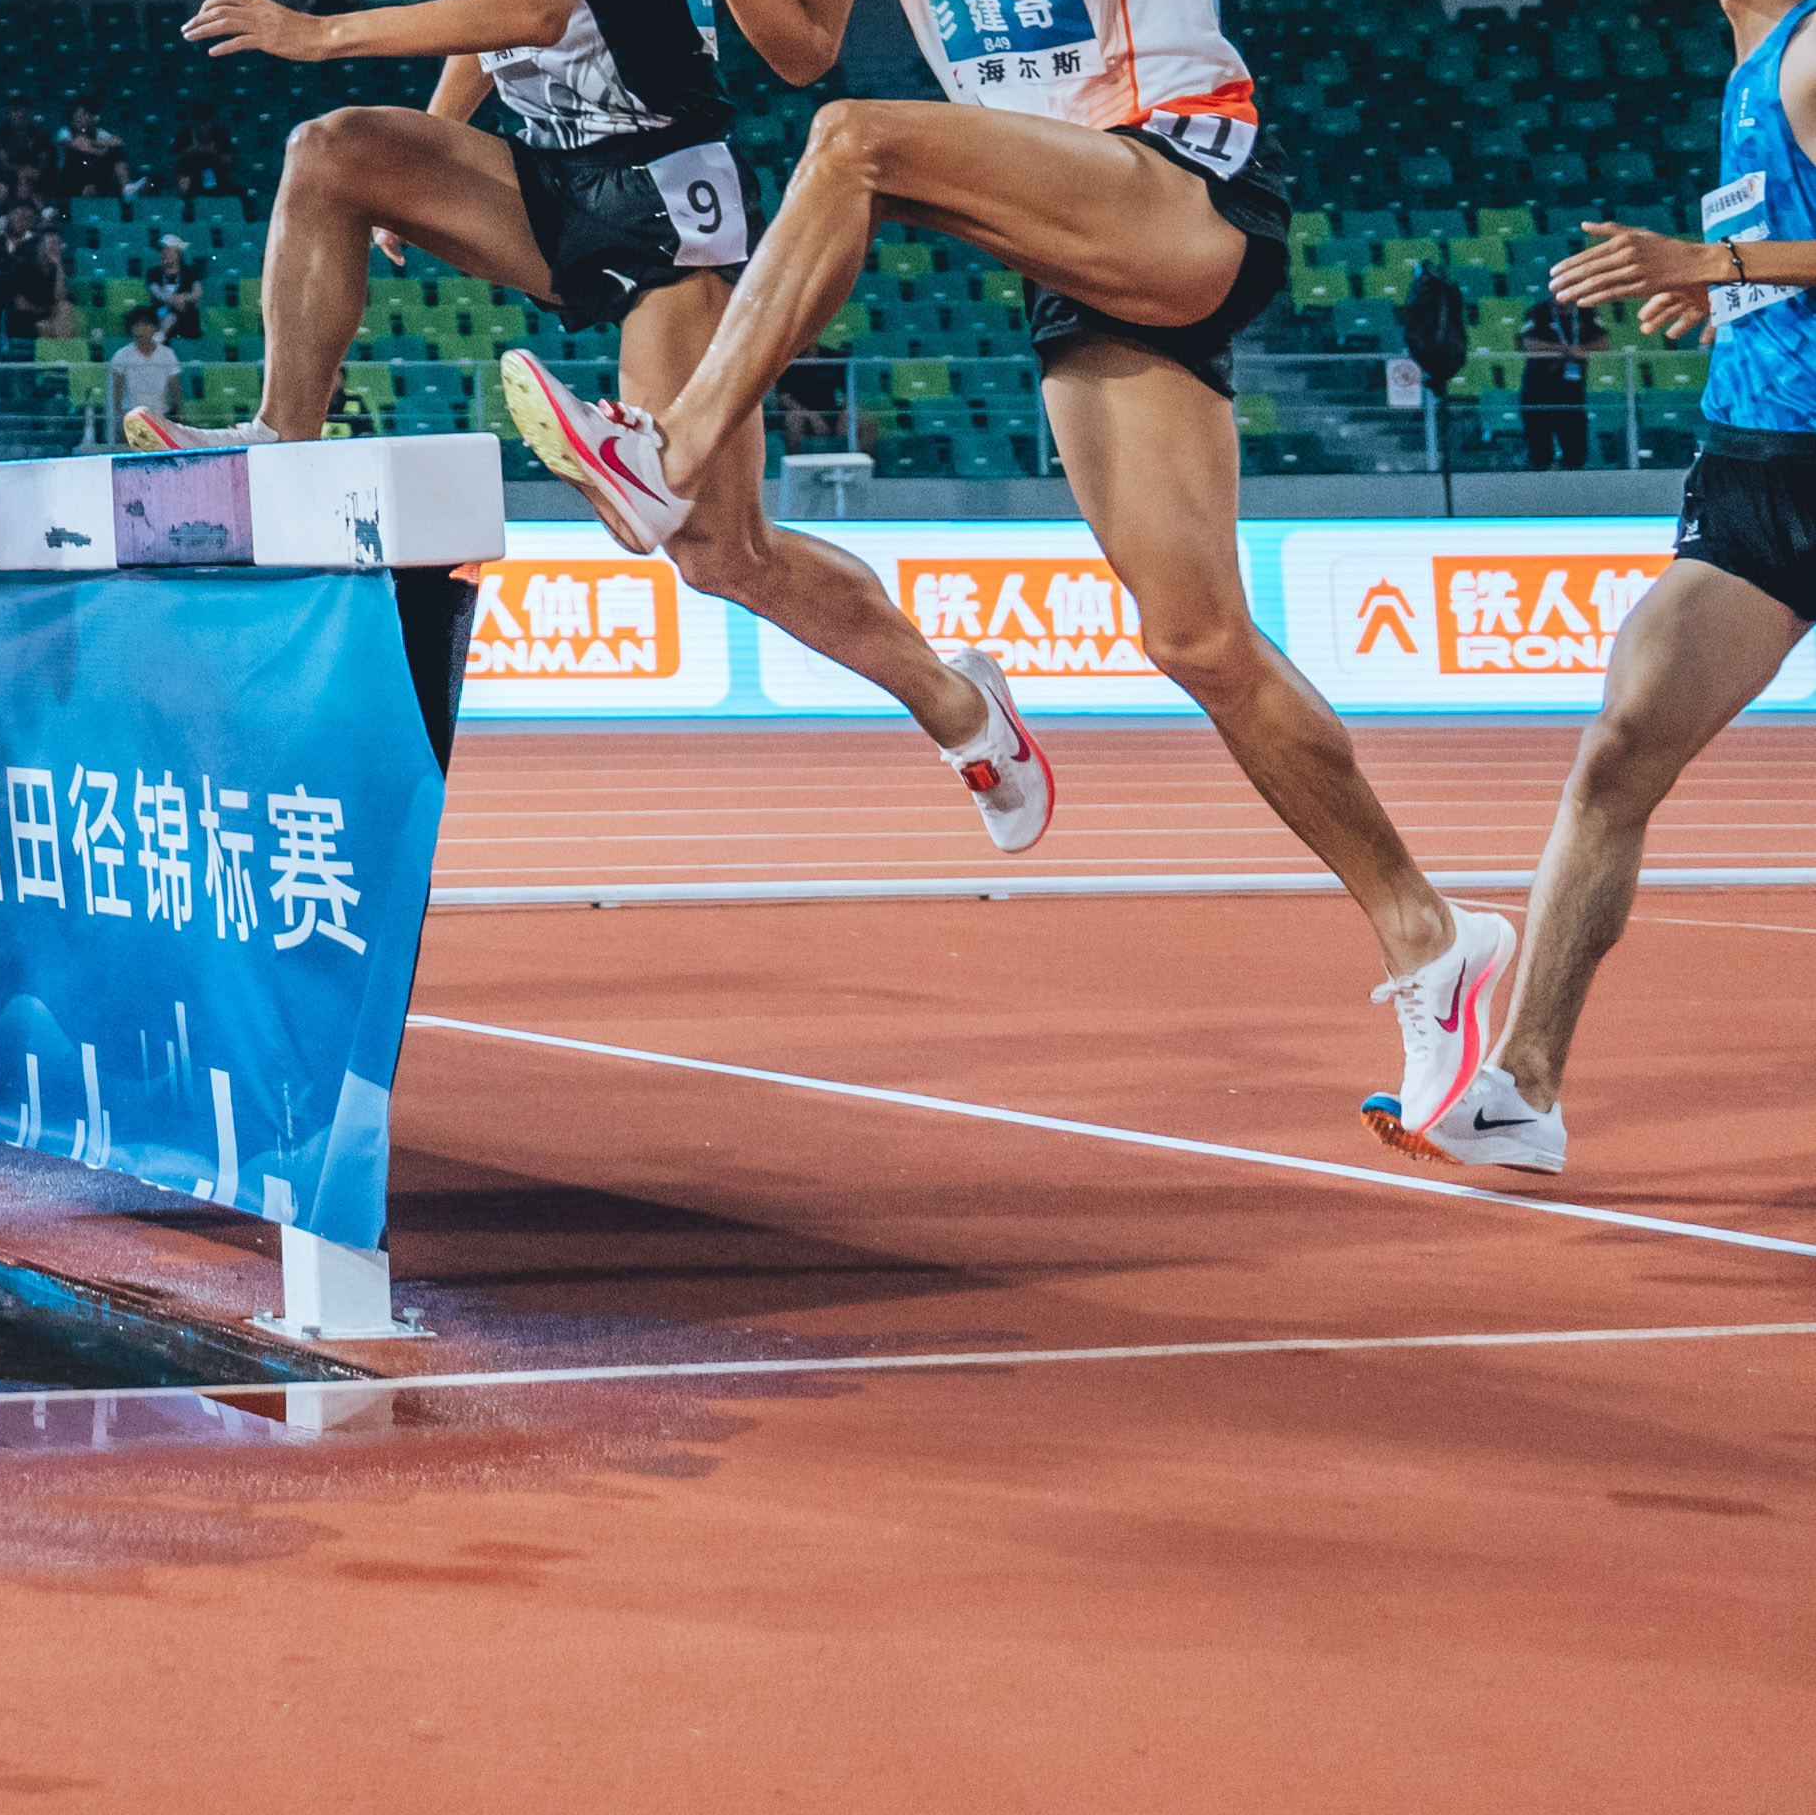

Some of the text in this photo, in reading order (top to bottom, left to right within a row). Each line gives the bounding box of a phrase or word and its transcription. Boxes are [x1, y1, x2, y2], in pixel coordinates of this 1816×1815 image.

[983, 35, 1012, 53] 849
[976, 50, 1082, 85] 海尔斯
[686, 179, 723, 234] 9
[913, 572, 1141, 636] 铁人体
[1457, 634, 1615, 670] IRON
